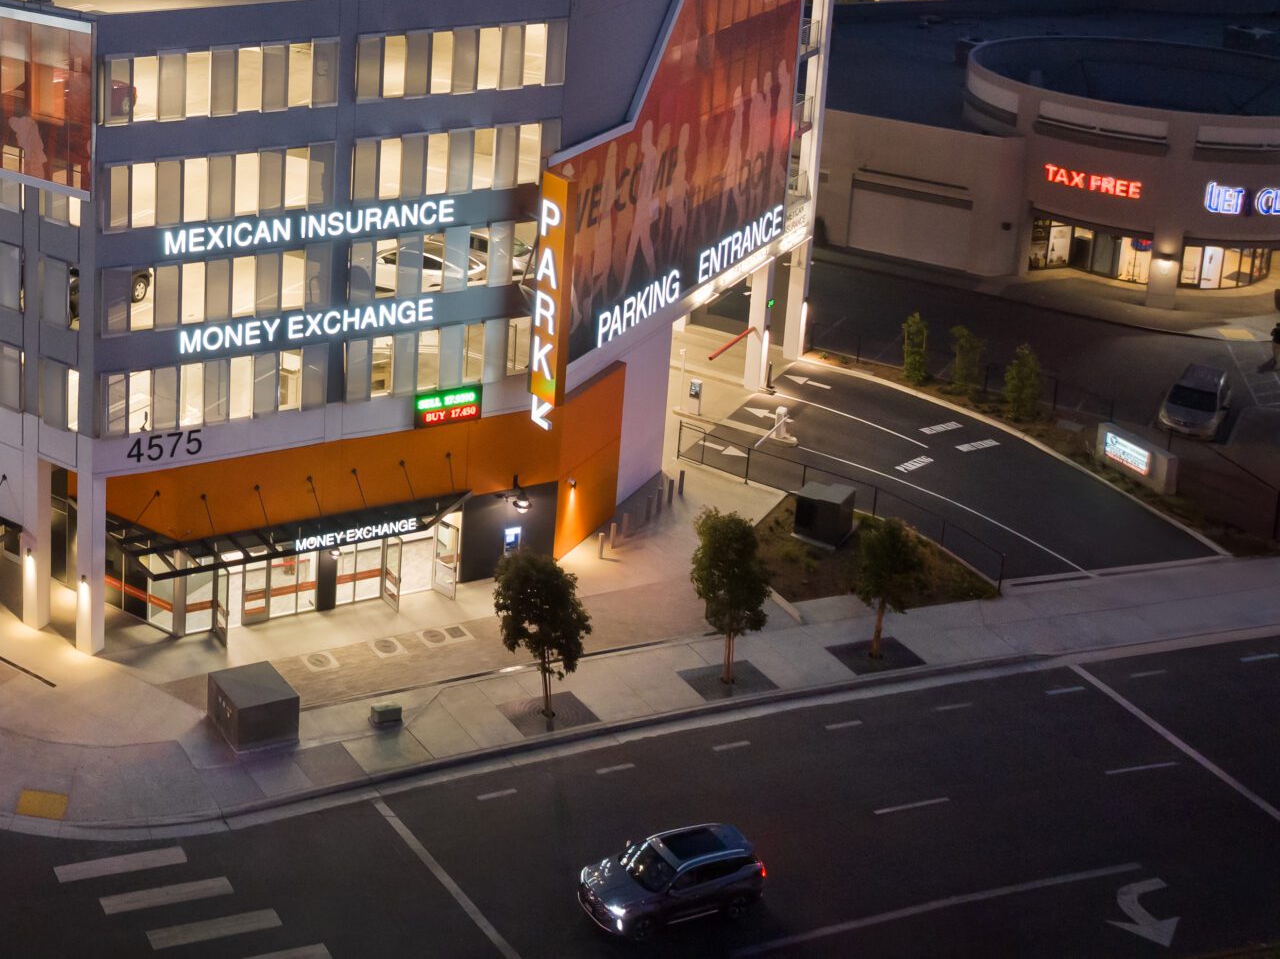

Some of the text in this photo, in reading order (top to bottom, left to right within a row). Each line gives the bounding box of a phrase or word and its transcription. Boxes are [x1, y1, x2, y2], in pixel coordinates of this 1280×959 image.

[1044, 163, 1143, 199] TAX FREE
[164, 198, 456, 255] MEXICAN INSURANCE
[532, 198, 561, 381] PARK
[597, 204, 784, 349] PARKING ENTRANCE
[179, 298, 435, 354] MONEY EXCHANGE
[425, 410, 446, 422] BUY
[126, 429, 203, 463] 4575
[295, 517, 418, 552] MONEY EXCHANGE
